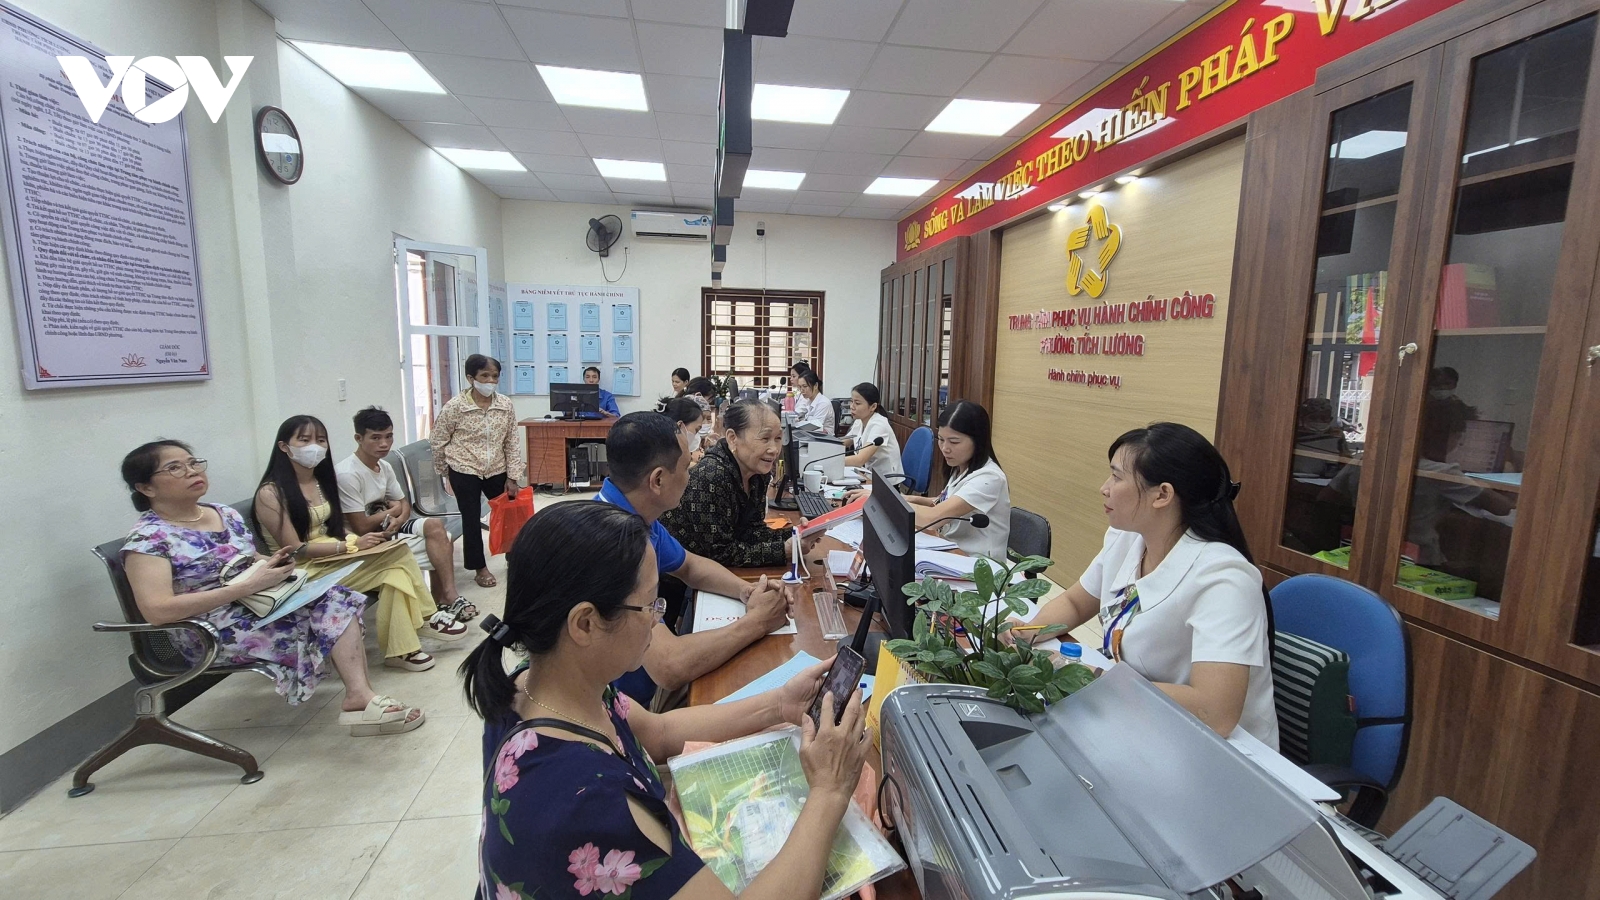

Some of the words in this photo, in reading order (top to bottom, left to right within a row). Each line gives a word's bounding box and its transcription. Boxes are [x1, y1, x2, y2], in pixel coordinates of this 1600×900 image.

[924, 207, 949, 239] SỐNG
[950, 196, 966, 225] VÀ
[966, 184, 995, 218] LÀM
[995, 160, 1034, 201] VIỆC
[1036, 130, 1092, 182] THEO
[1094, 76, 1170, 153] HIẾN
[1176, 12, 1296, 111] PHÁP
[1009, 313, 1033, 330] TRUNG
[1052, 309, 1076, 331] PHỤC
[1077, 307, 1092, 329] VỤ
[1092, 301, 1126, 324] HÀNH
[1128, 295, 1168, 322] CHÍNH
[1170, 290, 1215, 320] CÔNG
[1077, 331, 1100, 354] TÍCH
[1102, 332, 1145, 356] LƯƠNG
[1048, 368, 1065, 381] Hành
[1066, 370, 1086, 384] chính
[1087, 371, 1108, 388] phục
[1109, 375, 1121, 389] vụ
